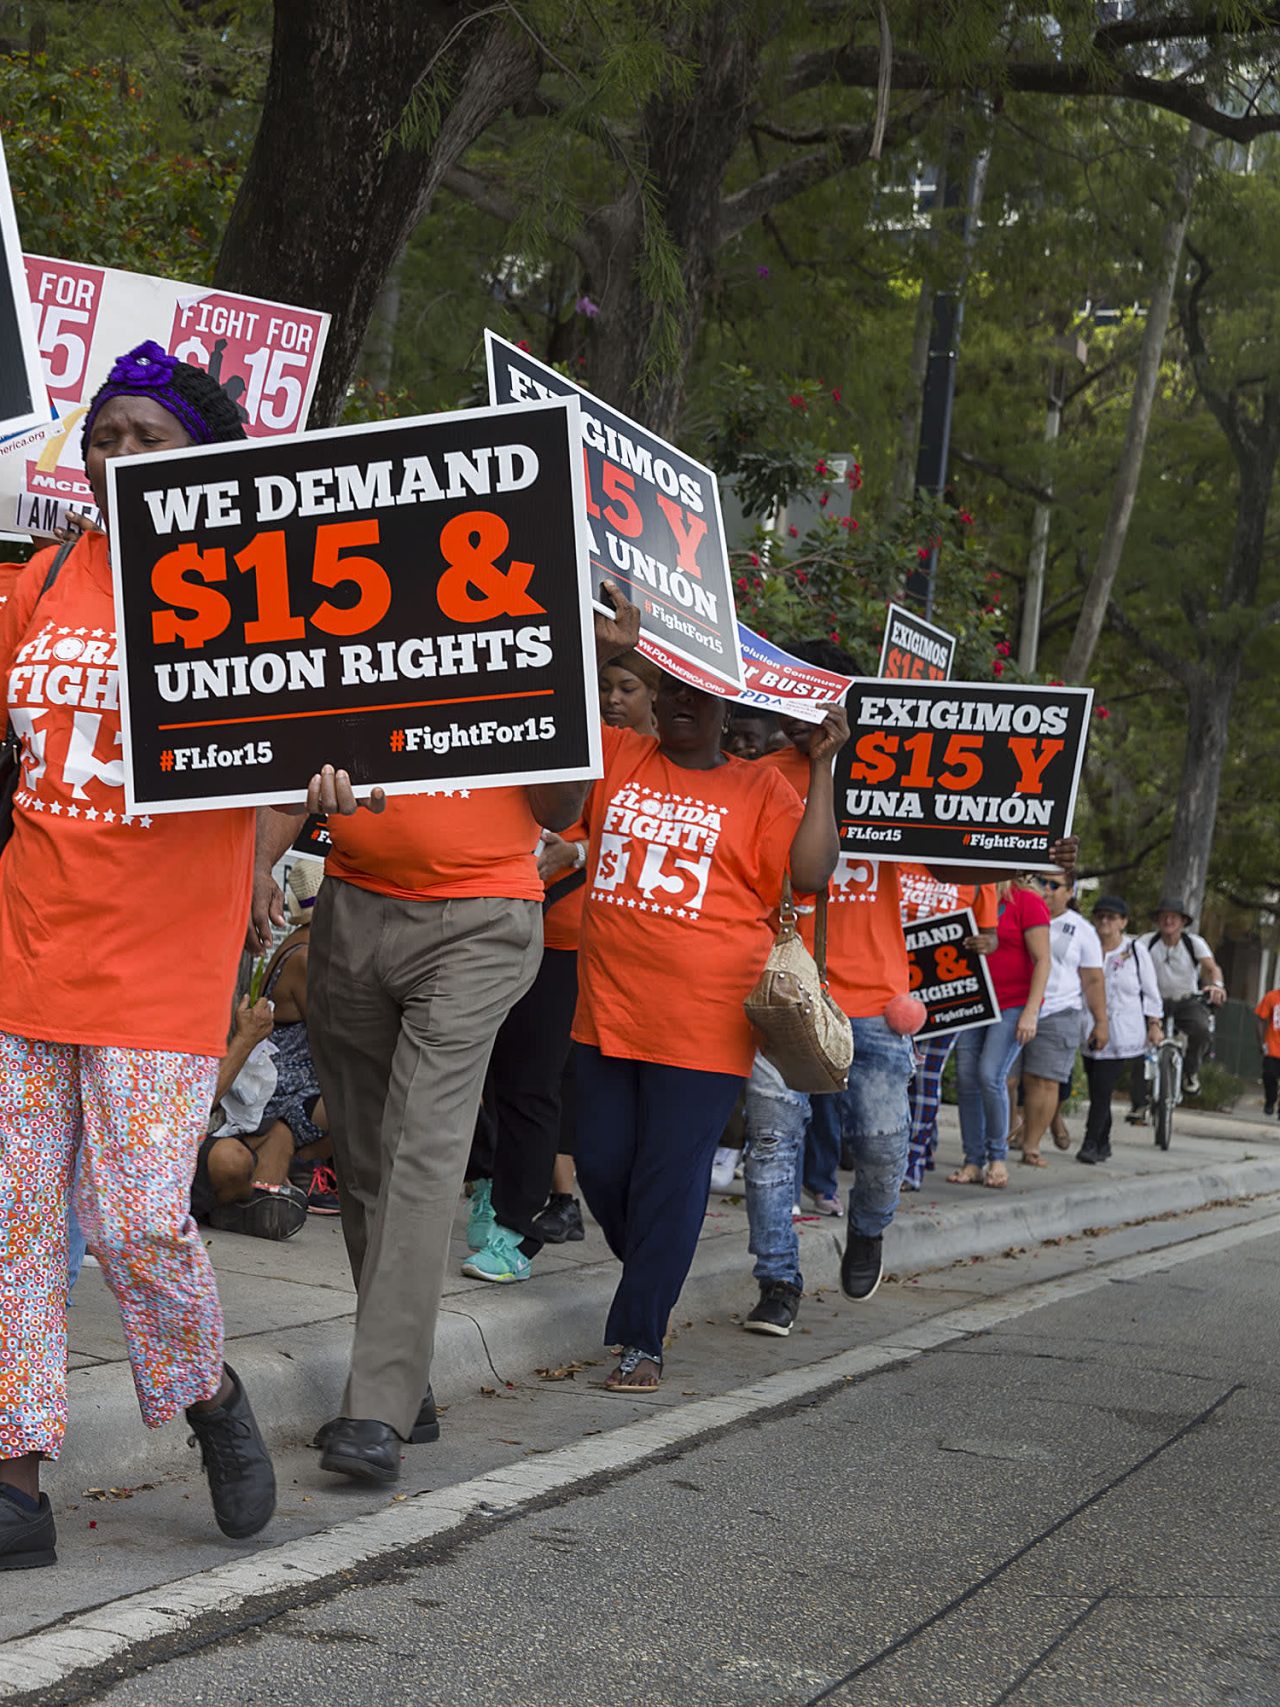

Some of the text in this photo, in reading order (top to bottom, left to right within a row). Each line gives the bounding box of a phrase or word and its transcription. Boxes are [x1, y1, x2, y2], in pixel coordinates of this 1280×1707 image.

[181, 304, 314, 352] FIGHT FOR
[143, 444, 540, 535] WE DEMAND
[657, 493, 708, 579] Y
[151, 510, 548, 650] $15 &
[605, 532, 719, 625] UNIÓN
[643, 600, 724, 654] #FightFor15
[891, 620, 949, 670] EXIGIMOS
[154, 625, 554, 702] UNION RIGHTS
[759, 671, 836, 702] BUST!
[783, 666, 843, 690] Continues
[857, 696, 1069, 736] EXIGIMOS
[160, 717, 556, 772] #FLfor15 #FightFor15
[850, 731, 1065, 794] $15 Y
[603, 805, 709, 851] FIGHT
[845, 789, 1054, 826] UNA UNIÓN
[839, 826, 1047, 850] #FLfor15 #FightFor15
[934, 945, 974, 982] &
